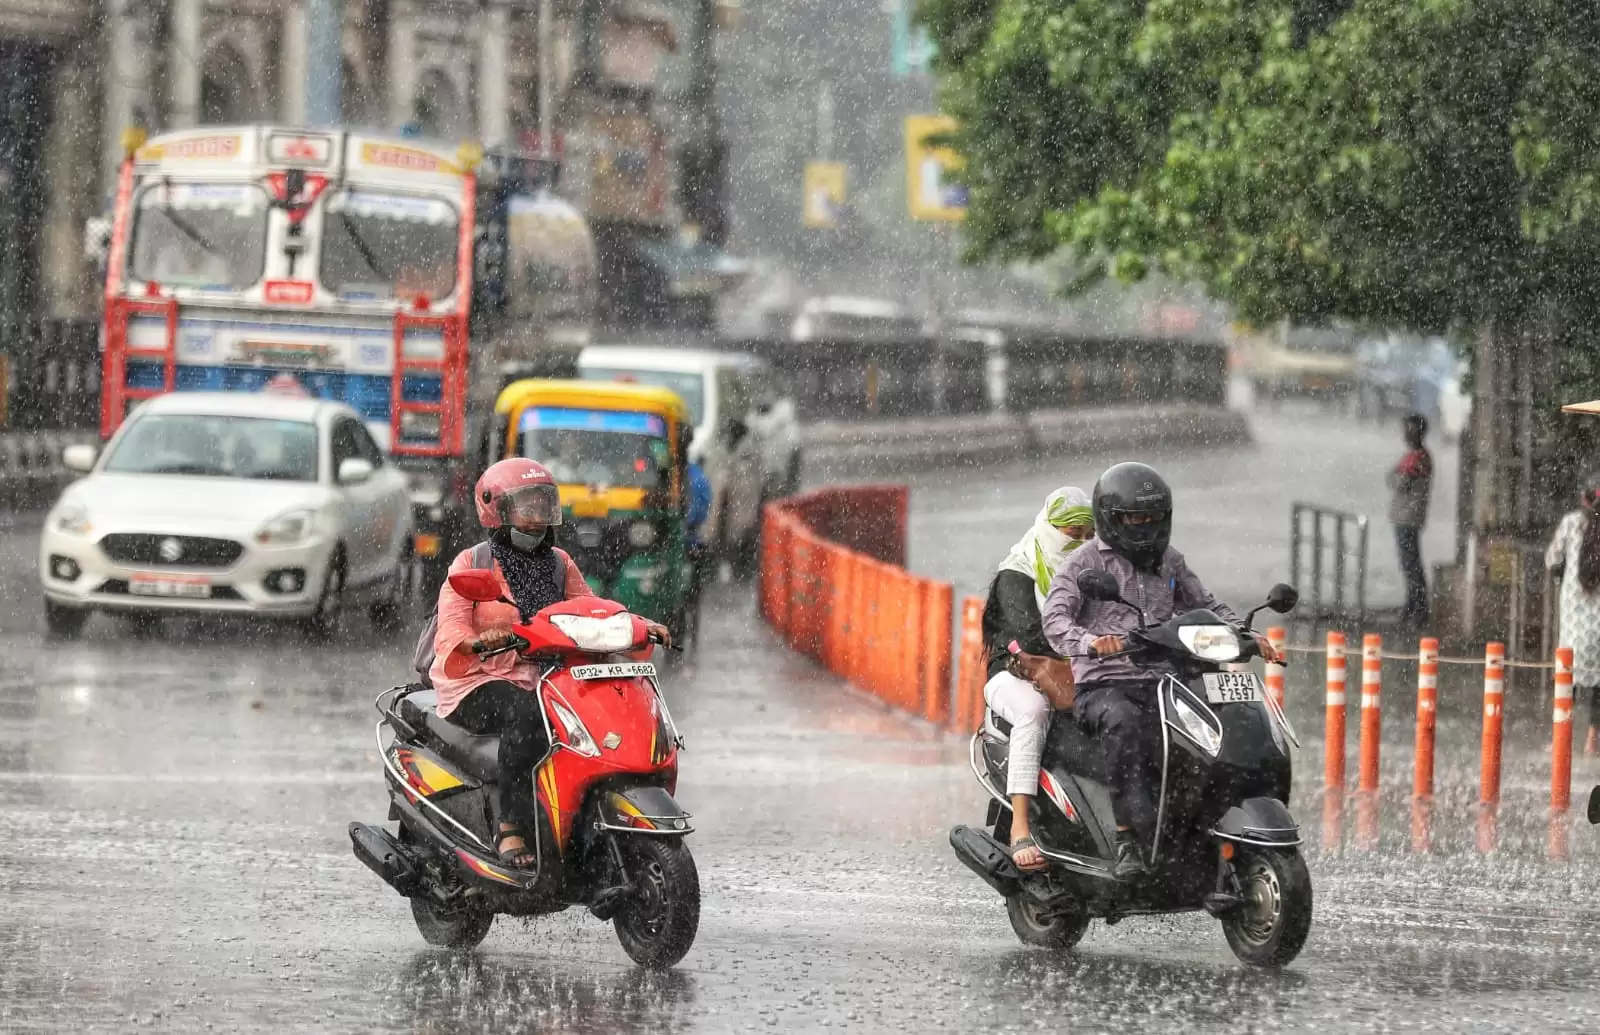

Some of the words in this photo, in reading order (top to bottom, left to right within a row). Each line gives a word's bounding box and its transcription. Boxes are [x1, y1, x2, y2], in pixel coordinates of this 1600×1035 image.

[572, 667, 599, 679] UP32
[608, 665, 624, 676] KR
[631, 665, 655, 675] 6682
[1217, 674, 1254, 687] UP32H
[1219, 687, 1255, 701] F2597
